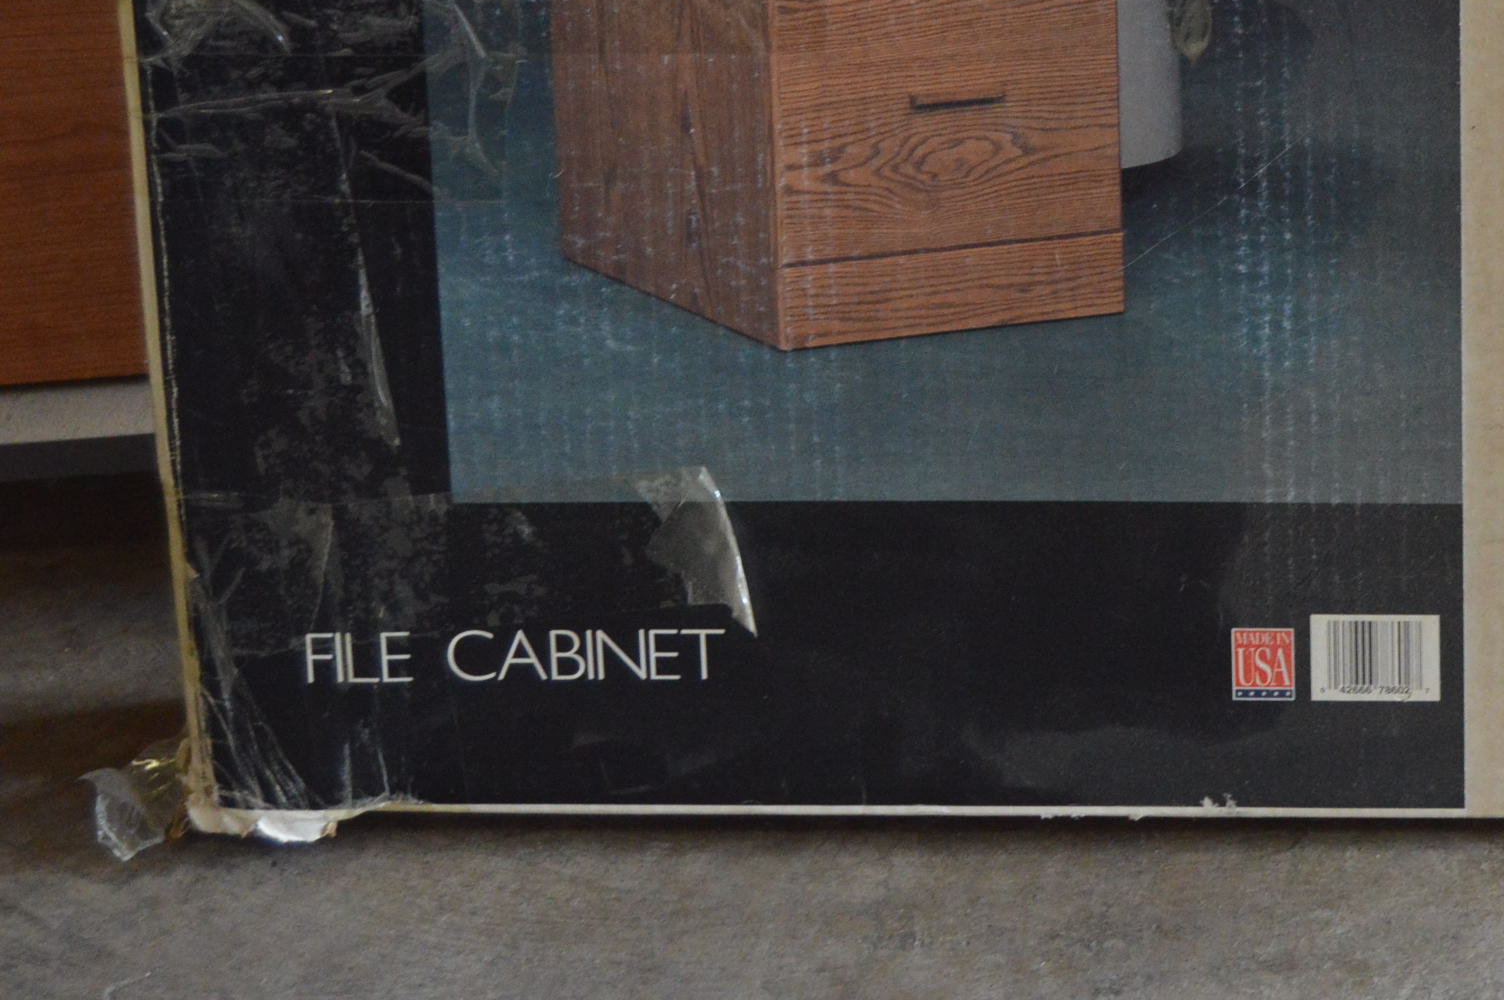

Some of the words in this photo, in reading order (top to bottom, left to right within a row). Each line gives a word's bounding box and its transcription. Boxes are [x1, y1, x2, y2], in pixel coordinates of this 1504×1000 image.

[304, 631, 414, 684] FILE
[446, 628, 726, 682] CABINET
[1236, 632, 1275, 644] MADE
[1276, 632, 1291, 643] IN
[1237, 648, 1291, 687] USA
